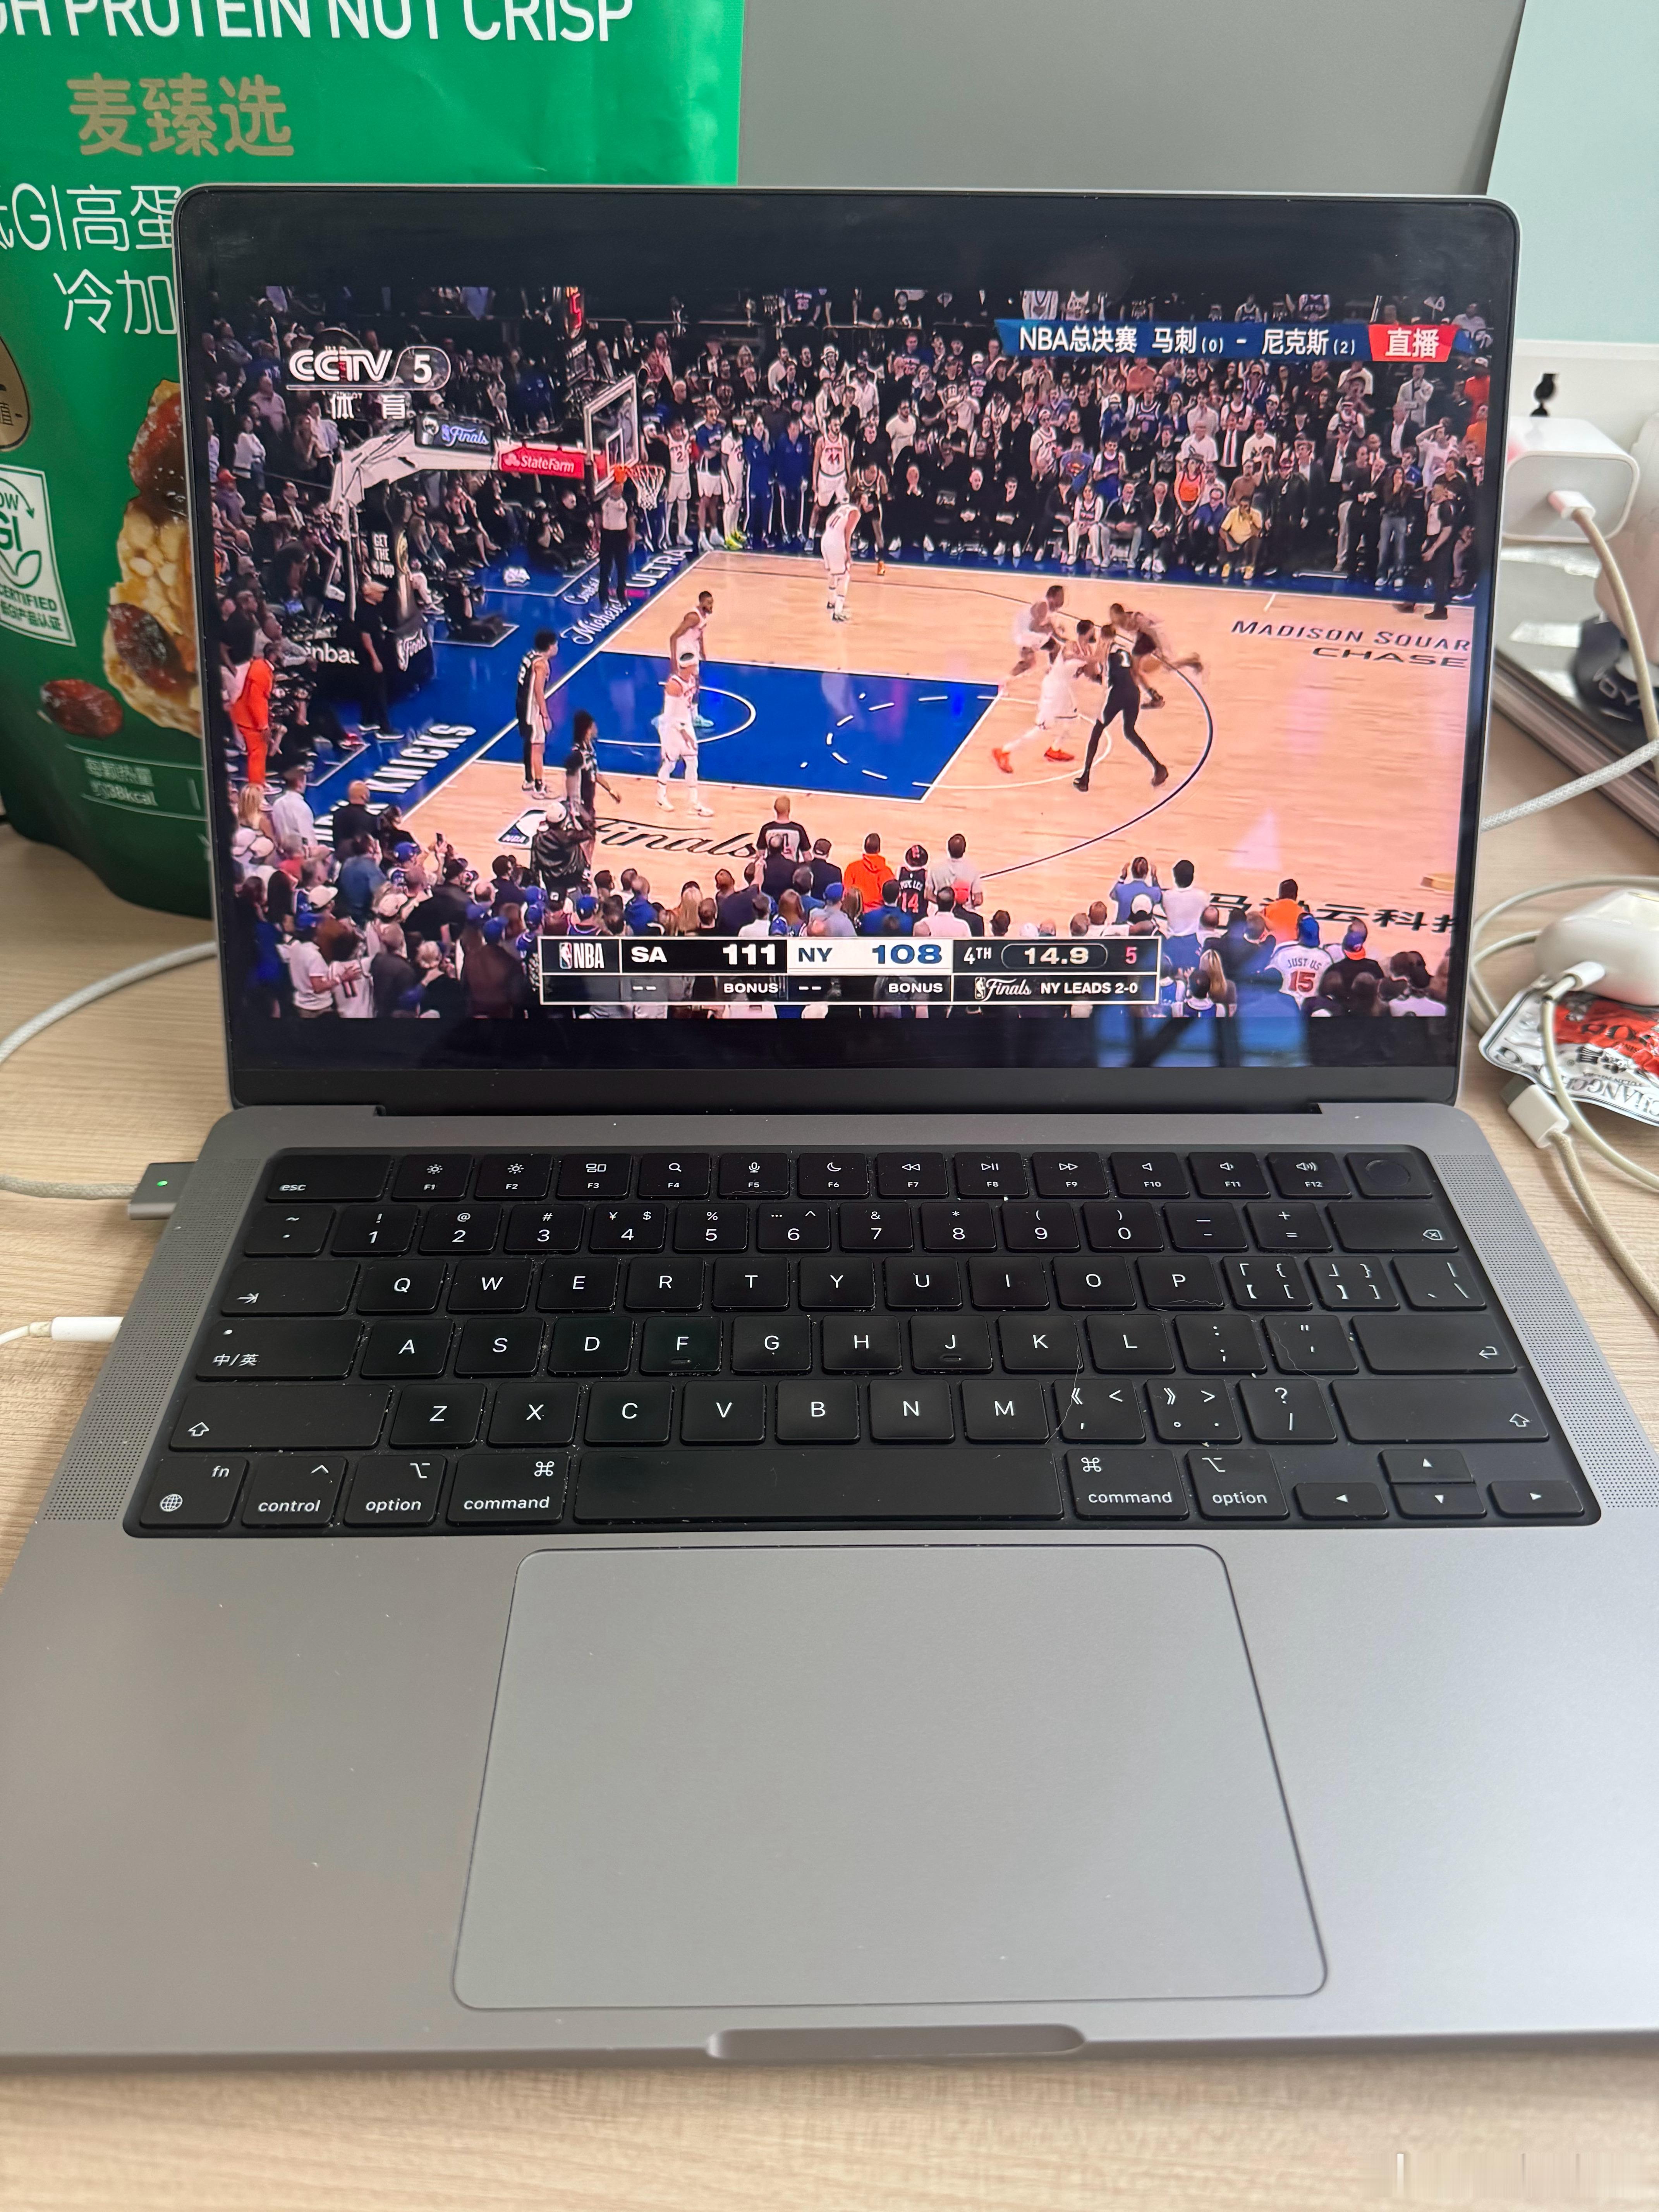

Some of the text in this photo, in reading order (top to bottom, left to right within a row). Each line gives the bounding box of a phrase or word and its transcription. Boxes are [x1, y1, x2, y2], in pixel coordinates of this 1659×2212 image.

[0, 0, 632, 41] H PROTEIN NUT CRISP
[67, 72, 294, 156] 麦臻选
[0, 183, 182, 252] GI高蛋
[53, 268, 178, 335] 冷加
[1019, 326, 1138, 354] NBA总决赛
[1152, 326, 1197, 354] 马刺
[1262, 328, 1329, 356] 尼克斯
[1385, 328, 1439, 359] 直播
[289, 350, 432, 384] CCTV 5
[330, 392, 405, 420] 体育
[445, 426, 490, 446] Finals
[626, 548, 693, 588] ULTRA
[1231, 620, 1364, 643] MADISON
[1312, 647, 1468, 668] CHASE
[364, 724, 477, 793] KNICKS
[901, 893, 919, 914] 14
[574, 943, 1137, 968] NBA SA 111 NY 108 4TH 14.9 5
[1287, 957, 1309, 969] JUST
[724, 982, 779, 994] BONUS
[889, 983, 943, 993] BONUS
[1288, 971, 1316, 993] 15
[985, 979, 1138, 1002] Finals NY LEADS 2-0
[369, 1231, 378, 1243] 1
[452, 1230, 465, 1242] 2
[538, 1230, 550, 1242] 3
[621, 1229, 634, 1240] 4
[706, 1229, 717, 1241] 5
[788, 1228, 800, 1240] 6
[871, 1228, 881, 1239] 7
[953, 1228, 965, 1240] 8
[1035, 1228, 1047, 1239] 9
[1118, 1228, 1131, 1239] 0
[394, 1278, 410, 1292] Q
[482, 1277, 503, 1290] W
[573, 1276, 586, 1289] E
[659, 1276, 672, 1288] R
[745, 1275, 758, 1288] T
[830, 1275, 843, 1288] Y
[915, 1275, 929, 1287] U
[1006, 1274, 1010, 1287] I
[1086, 1274, 1101, 1287] O
[1172, 1274, 1185, 1287] P
[398, 1340, 414, 1354] A
[493, 1338, 507, 1352] S
[585, 1337, 599, 1351] D
[677, 1337, 689, 1350] F
[765, 1336, 779, 1350] G
[854, 1335, 869, 1348] H
[945, 1335, 955, 1349] J
[1033, 1335, 1048, 1348] K
[1123, 1334, 1137, 1348] L
[213, 1354, 259, 1366] 中/英
[430, 1406, 447, 1421] Z
[526, 1405, 544, 1420] X
[622, 1403, 637, 1419] C
[716, 1402, 732, 1417] V
[811, 1401, 825, 1417] B
[903, 1401, 919, 1416] N
[994, 1401, 1014, 1416] M
[212, 1466, 229, 1477] fn
[464, 1496, 549, 1510] command
[1089, 1492, 1172, 1503] command
[1212, 1492, 1267, 1506] option
[258, 1500, 320, 1511] control
[366, 1498, 421, 1513] option
